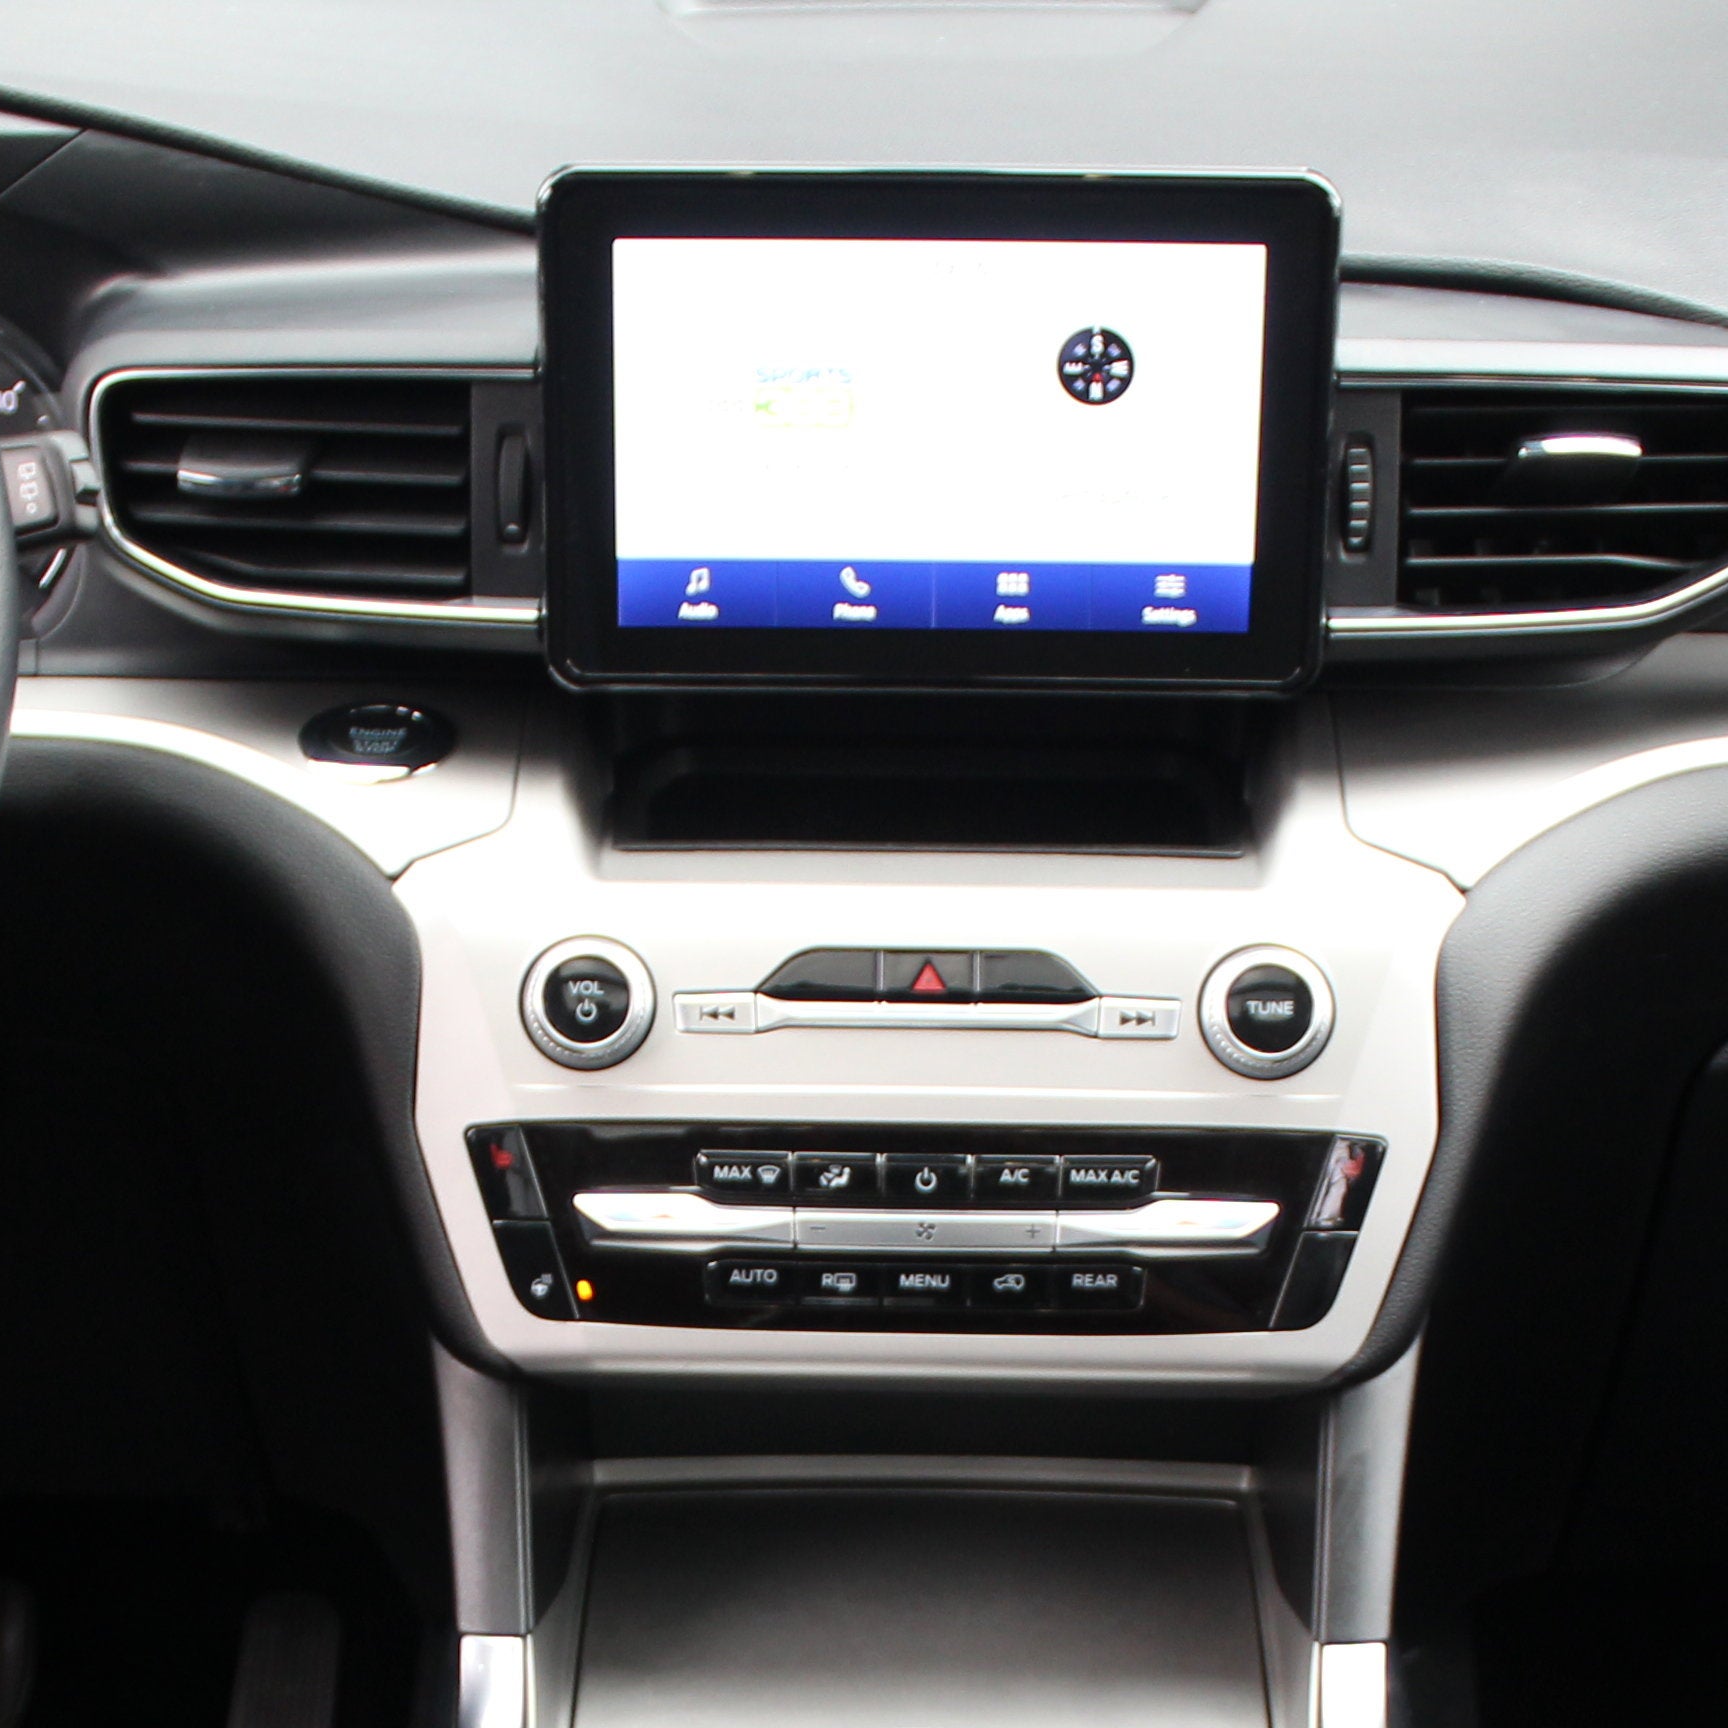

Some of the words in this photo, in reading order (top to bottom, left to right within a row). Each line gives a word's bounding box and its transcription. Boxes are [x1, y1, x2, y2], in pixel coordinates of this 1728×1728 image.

[1090, 334, 1105, 356] S
[677, 601, 720, 621] Audio
[832, 602, 878, 622] Phone
[993, 604, 1031, 625] Apps
[1140, 605, 1198, 628] Settings
[567, 979, 606, 997] VOL
[1245, 999, 1295, 1016] TUNE
[712, 1164, 753, 1181] MAX
[998, 1168, 1031, 1184] A/C
[1069, 1168, 1109, 1184] MAX
[1110, 1169, 1140, 1185] A/C
[728, 1268, 778, 1284] AUTO
[899, 1273, 951, 1289] MENU
[1071, 1273, 1118, 1289] REAR
